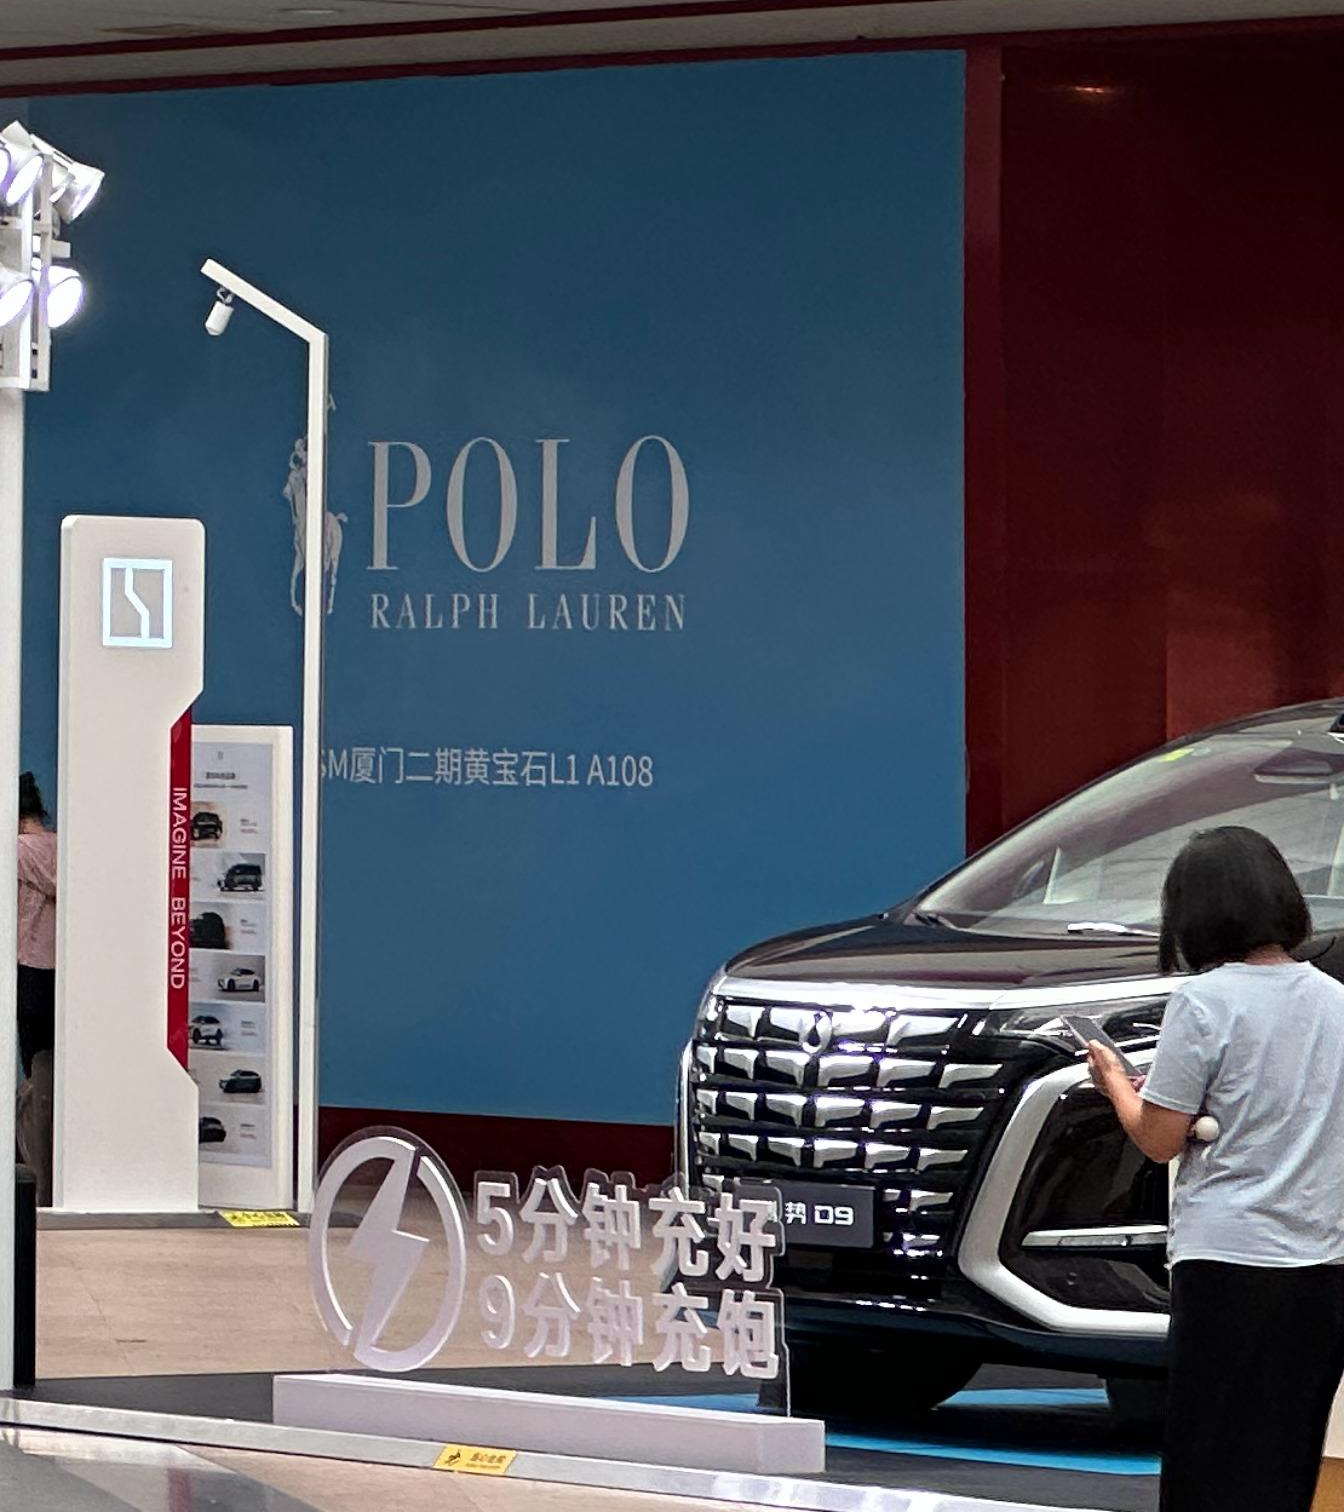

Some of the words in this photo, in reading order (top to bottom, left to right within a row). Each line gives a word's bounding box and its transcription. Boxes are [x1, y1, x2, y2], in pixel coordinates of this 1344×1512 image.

[365, 435, 691, 574] POLO
[370, 593, 499, 632] RALPH
[527, 592, 688, 633] LAUREN
[586, 754, 654, 788] A108
[172, 787, 188, 881] IMAGINE
[170, 897, 186, 989] BEYOND
[474, 1176, 776, 1283] 5分钟充好
[814, 1204, 854, 1226] D9
[479, 1272, 780, 1379] 9分钟充饱
